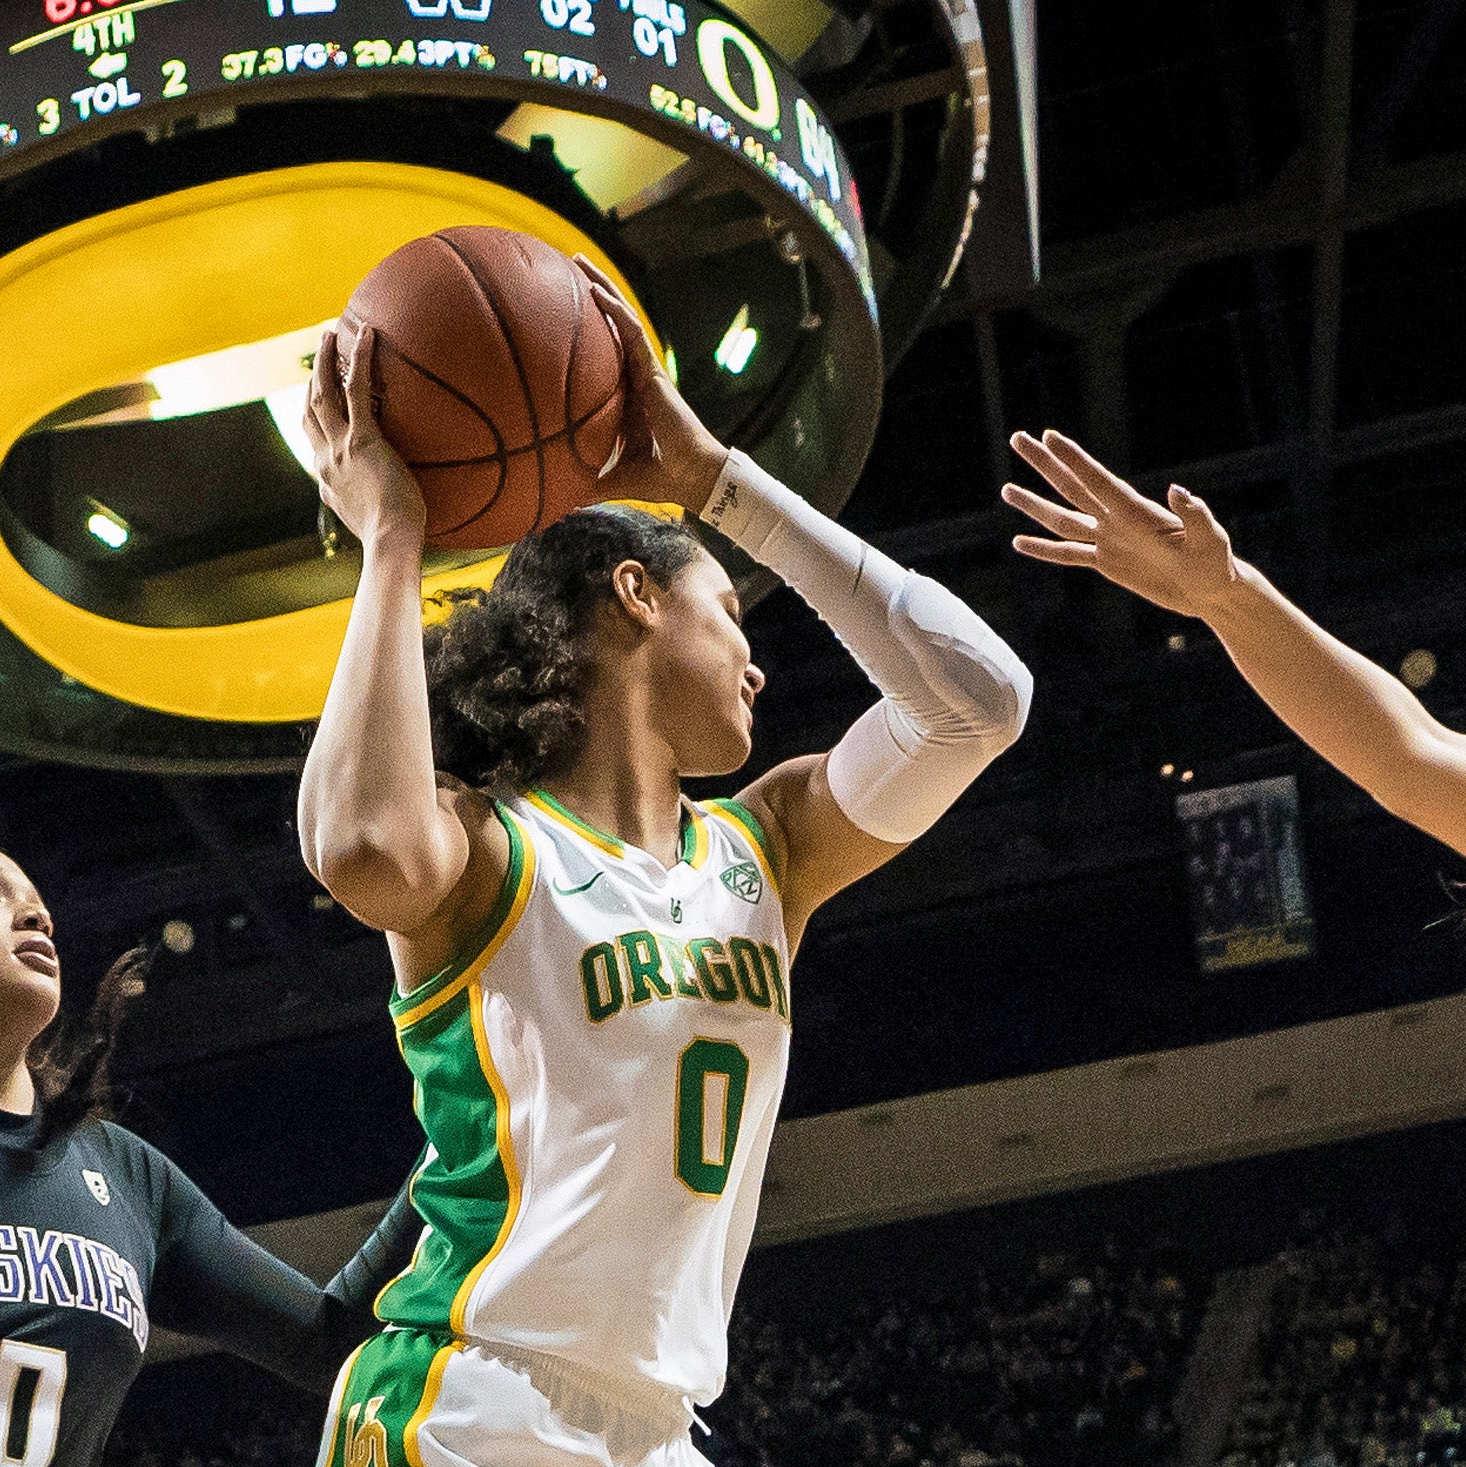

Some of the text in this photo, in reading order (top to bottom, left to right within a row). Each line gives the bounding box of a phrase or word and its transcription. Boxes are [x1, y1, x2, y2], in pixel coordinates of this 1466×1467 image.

[73, 10, 136, 56] 4TH
[36, 59, 189, 136] 3 TOL 2
[675, 1036, 751, 1201] 0
